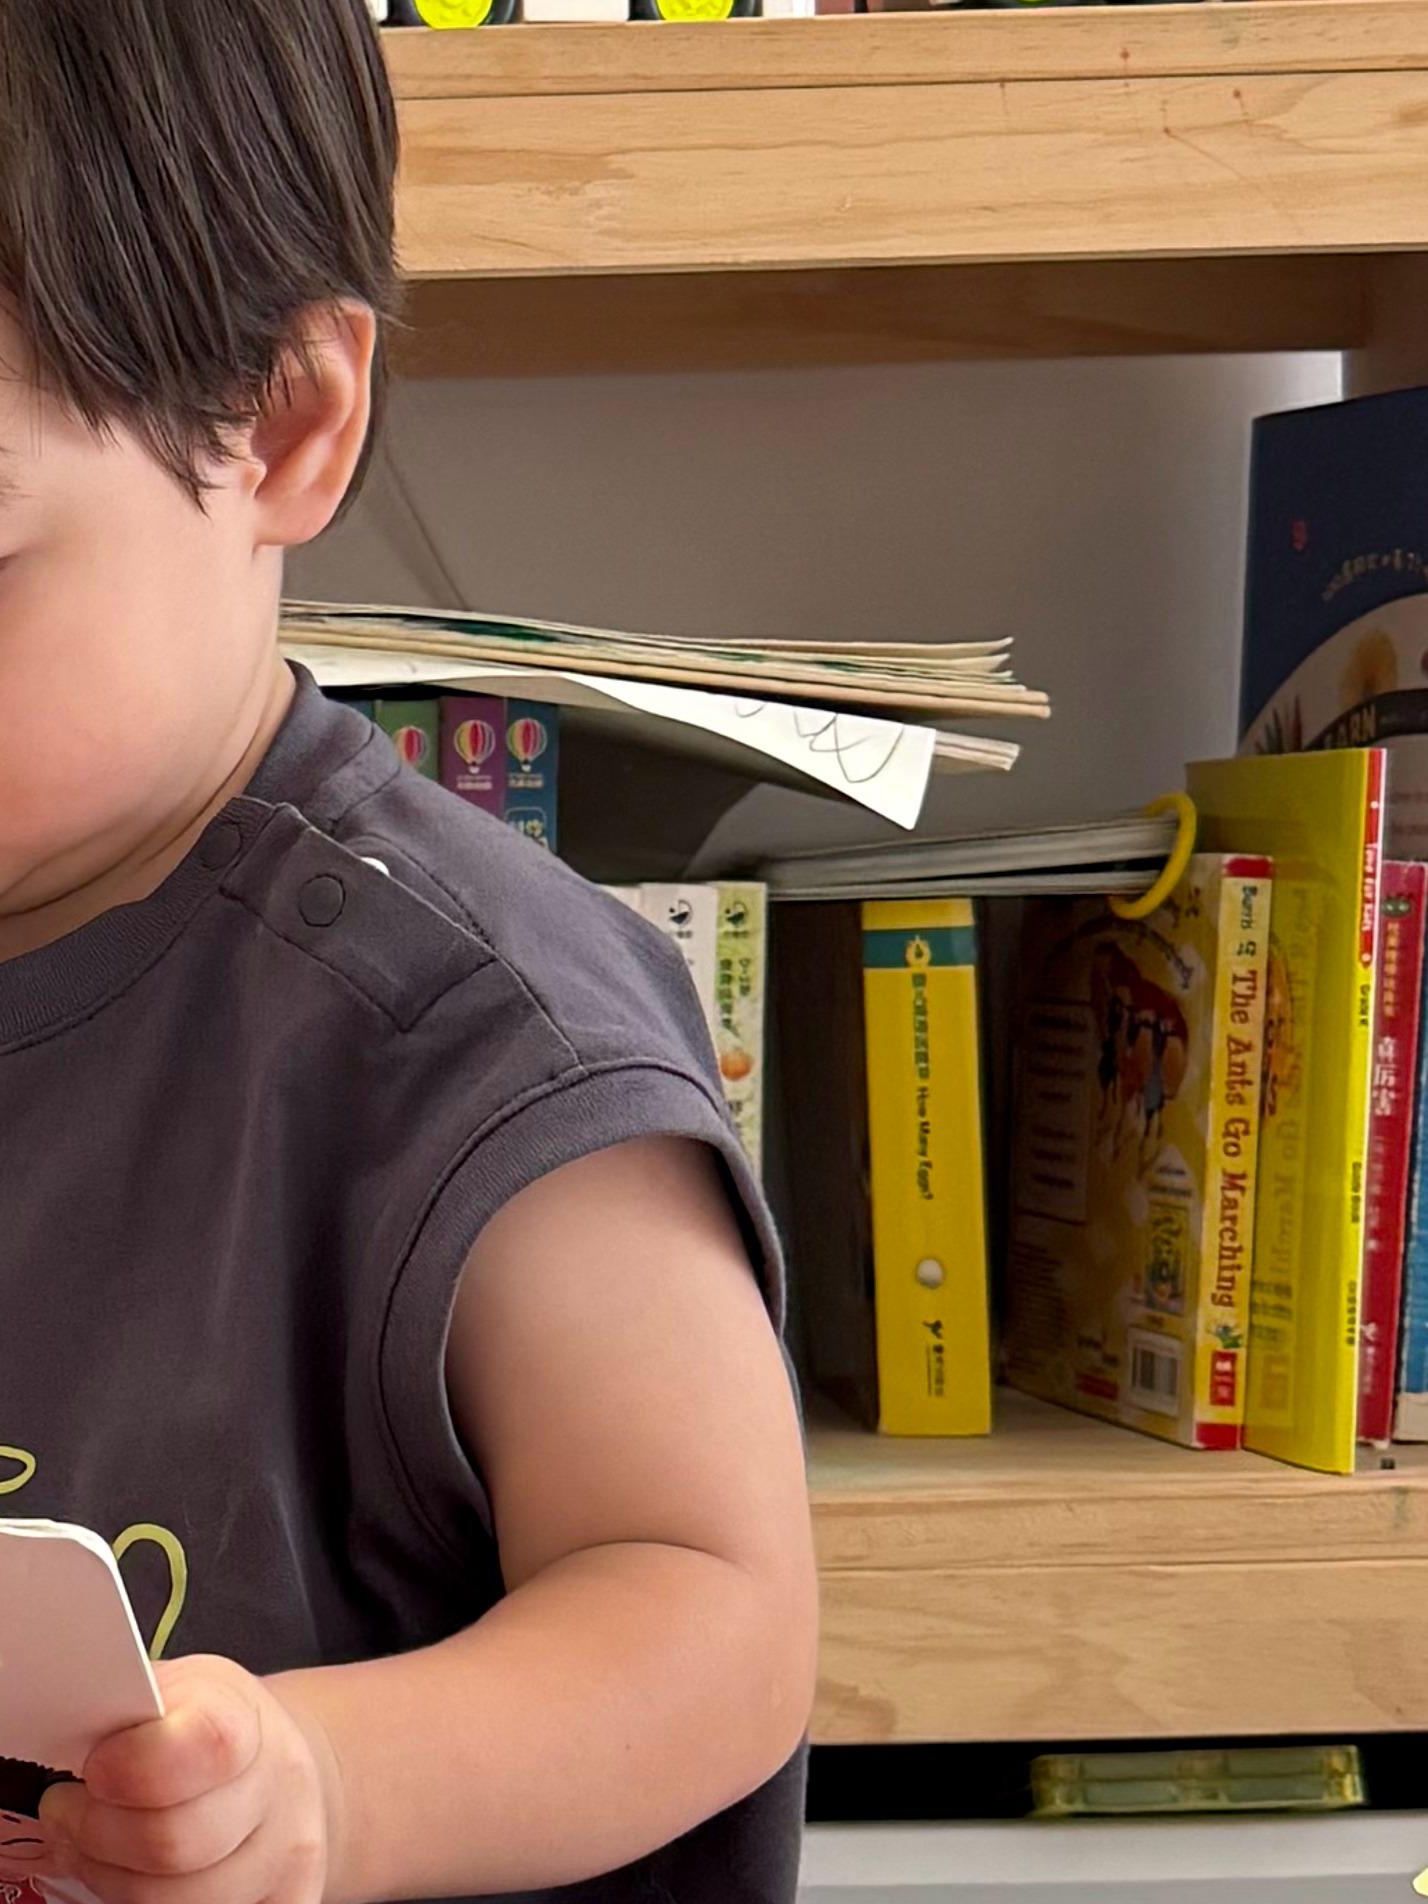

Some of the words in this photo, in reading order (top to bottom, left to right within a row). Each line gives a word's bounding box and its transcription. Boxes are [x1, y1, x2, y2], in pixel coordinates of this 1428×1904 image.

[1229, 969, 1258, 1026] The
[1226, 1037, 1251, 1107] Ants
[917, 1120, 931, 1160] Many
[1223, 1117, 1250, 1159] Go
[917, 1162, 934, 1201] Eggs?
[1210, 1173, 1247, 1310] Marching
